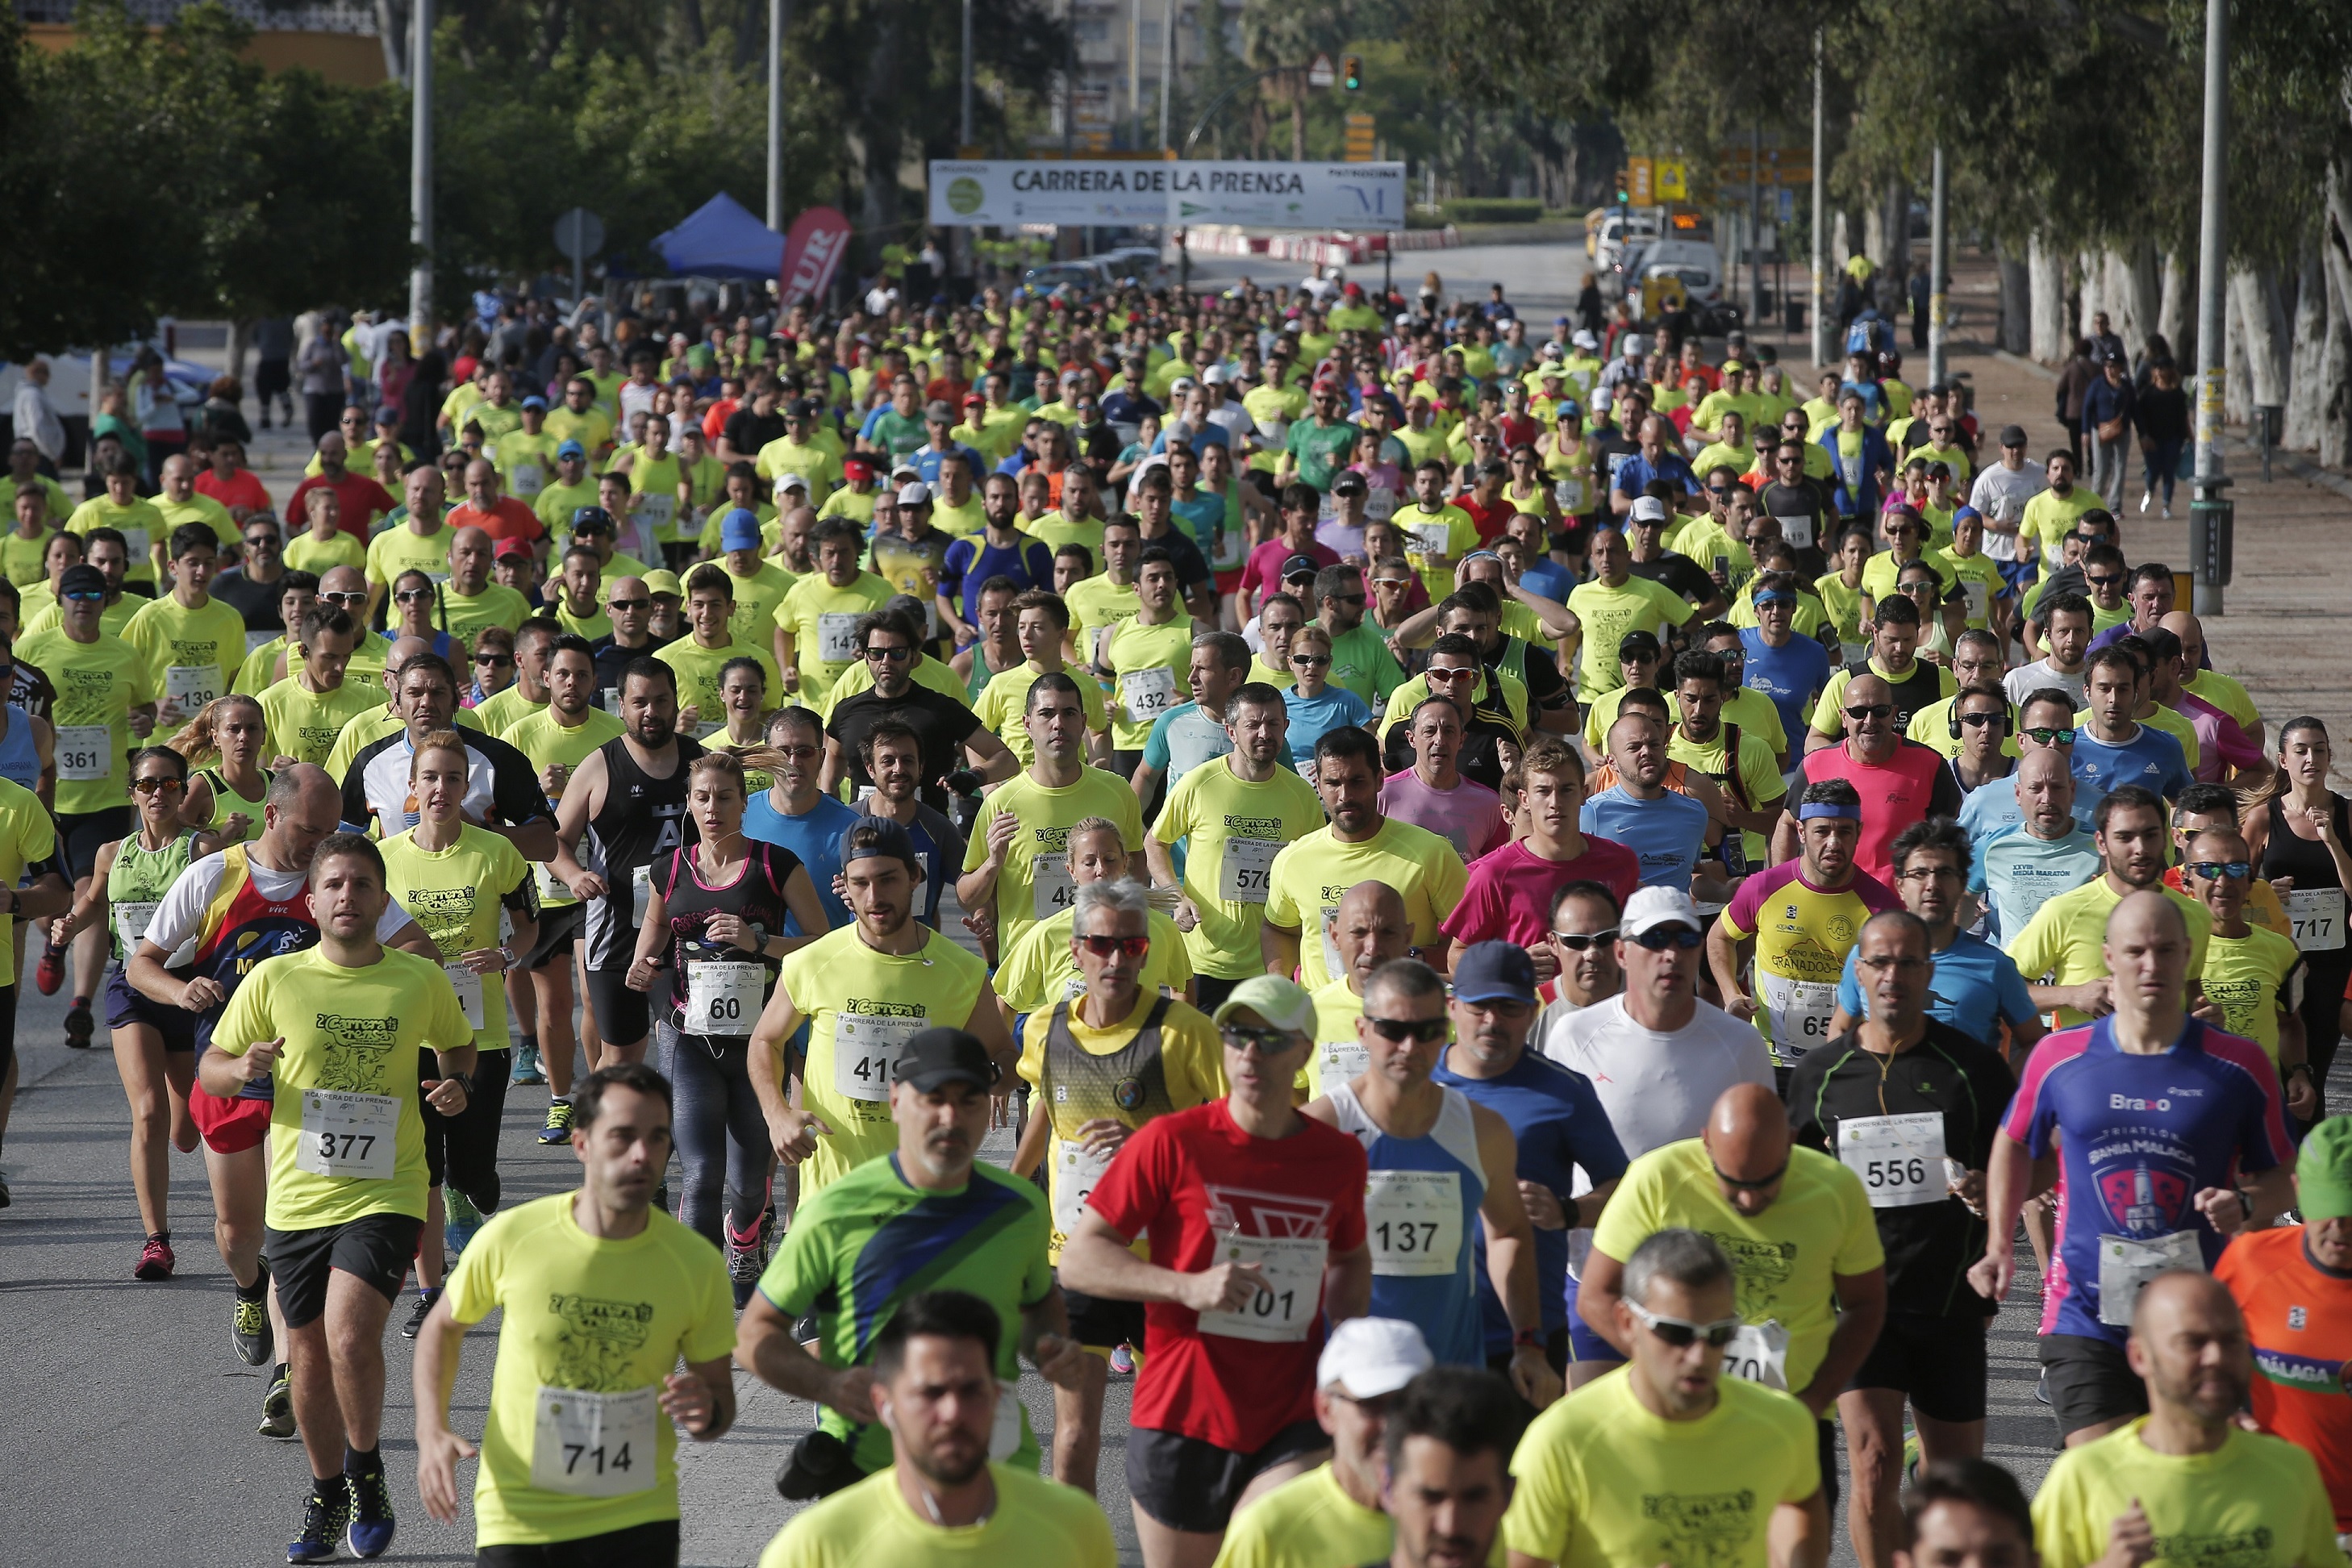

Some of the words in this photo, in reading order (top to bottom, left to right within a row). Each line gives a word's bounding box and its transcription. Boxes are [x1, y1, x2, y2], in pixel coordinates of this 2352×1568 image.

[1012, 169, 1127, 192] CARRERA
[1134, 170, 1166, 192] DE
[1172, 170, 1202, 192] LA
[1210, 172, 1305, 194] PRENSA
[182, 690, 214, 707] 139
[1136, 691, 1166, 710] 432
[63, 751, 98, 768] 361
[416, 888, 465, 903] Carrera
[2292, 918, 2333, 939] 717
[1784, 949, 1808, 958] HORNO
[1794, 983, 1820, 991] CARRERA
[710, 997, 740, 1020] 60
[855, 998, 915, 1018] Carrera
[324, 1014, 386, 1031] Carrera
[844, 1016, 875, 1025] CARRERA
[1328, 1045, 1360, 1053] CARRERA
[310, 1091, 343, 1102] CARRERA
[365, 1097, 393, 1106] PRENSA
[339, 1103, 356, 1111] APM
[319, 1132, 376, 1161] 377
[1868, 1158, 1925, 1188] 556
[1375, 1222, 1439, 1253] 137
[1238, 1288, 1295, 1322] 01
[564, 1441, 632, 1476] 714
